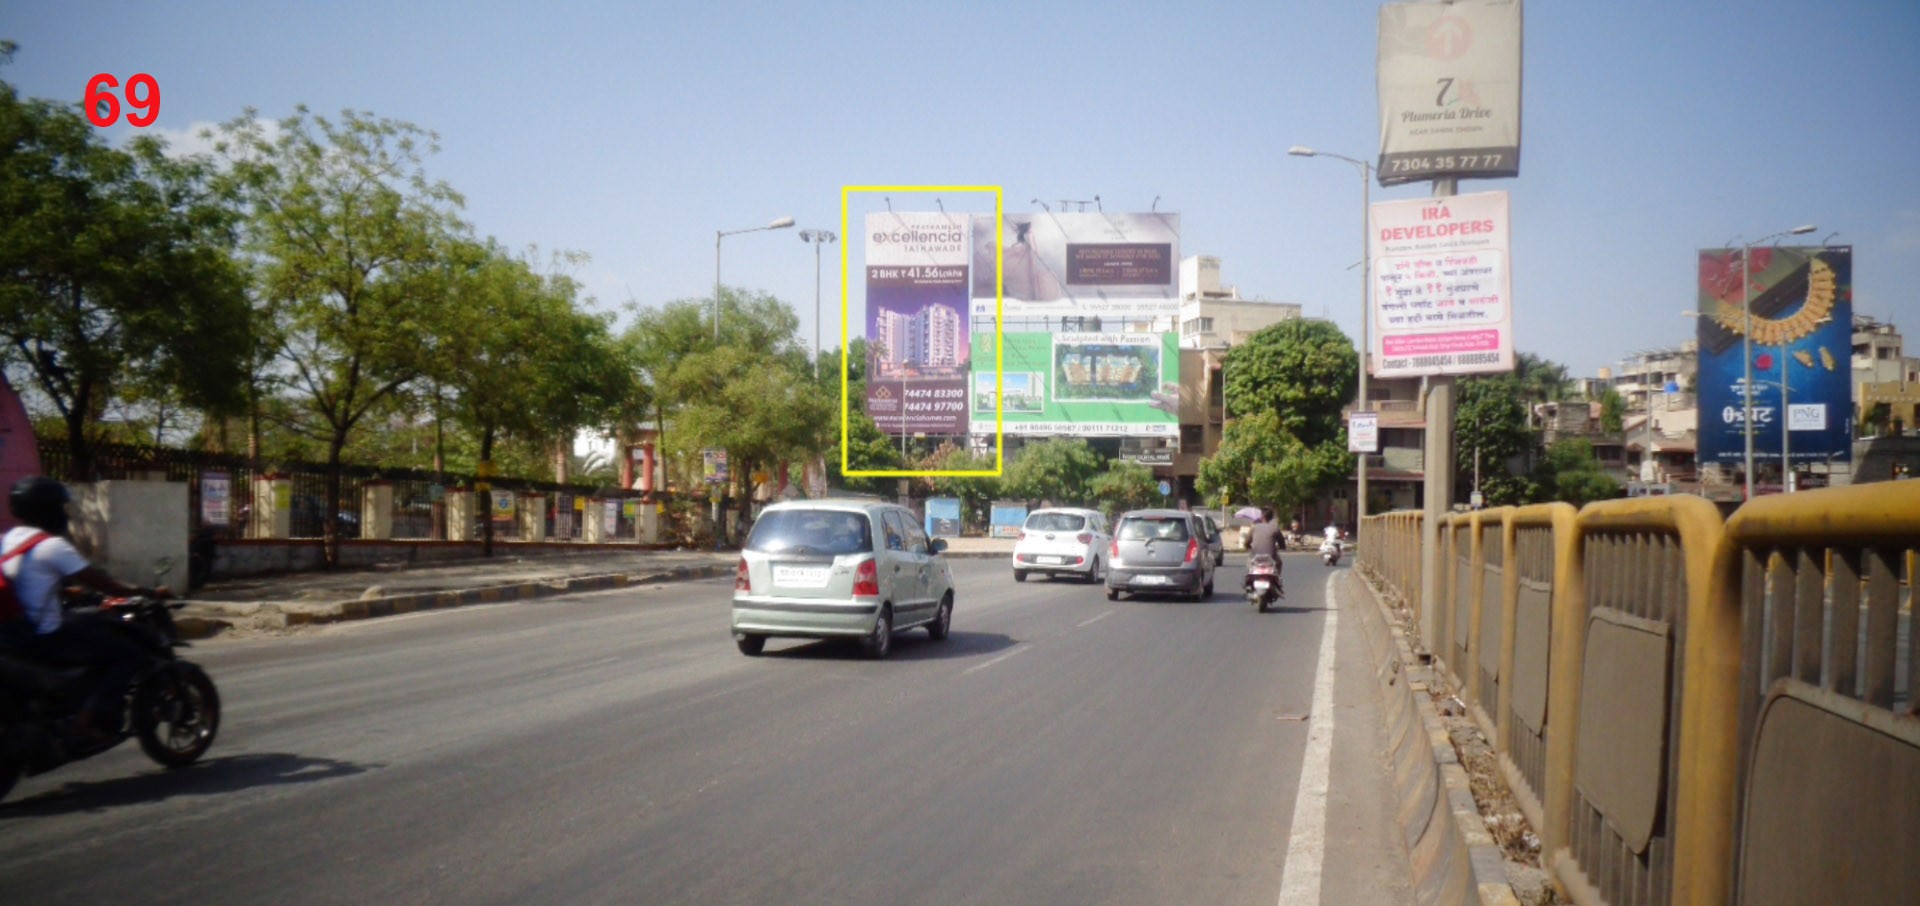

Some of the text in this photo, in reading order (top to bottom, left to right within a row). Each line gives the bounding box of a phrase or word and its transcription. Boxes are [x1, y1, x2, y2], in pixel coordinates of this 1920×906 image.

[1436, 78, 1454, 106] 7
[1401, 106, 1492, 123] Plumeria Drive
[1392, 154, 1502, 172] 7304 35 77 77
[1421, 205, 1451, 220] IRA
[872, 230, 962, 244] excellencia
[1380, 220, 1494, 242] DEVELOPERS
[871, 269, 878, 278] 2
[880, 269, 899, 278] BHK
[1382, 358, 1408, 369] Contact
[934, 389, 963, 398] 83300
[934, 401, 963, 411] 97700
[1793, 407, 1820, 419] PNG
